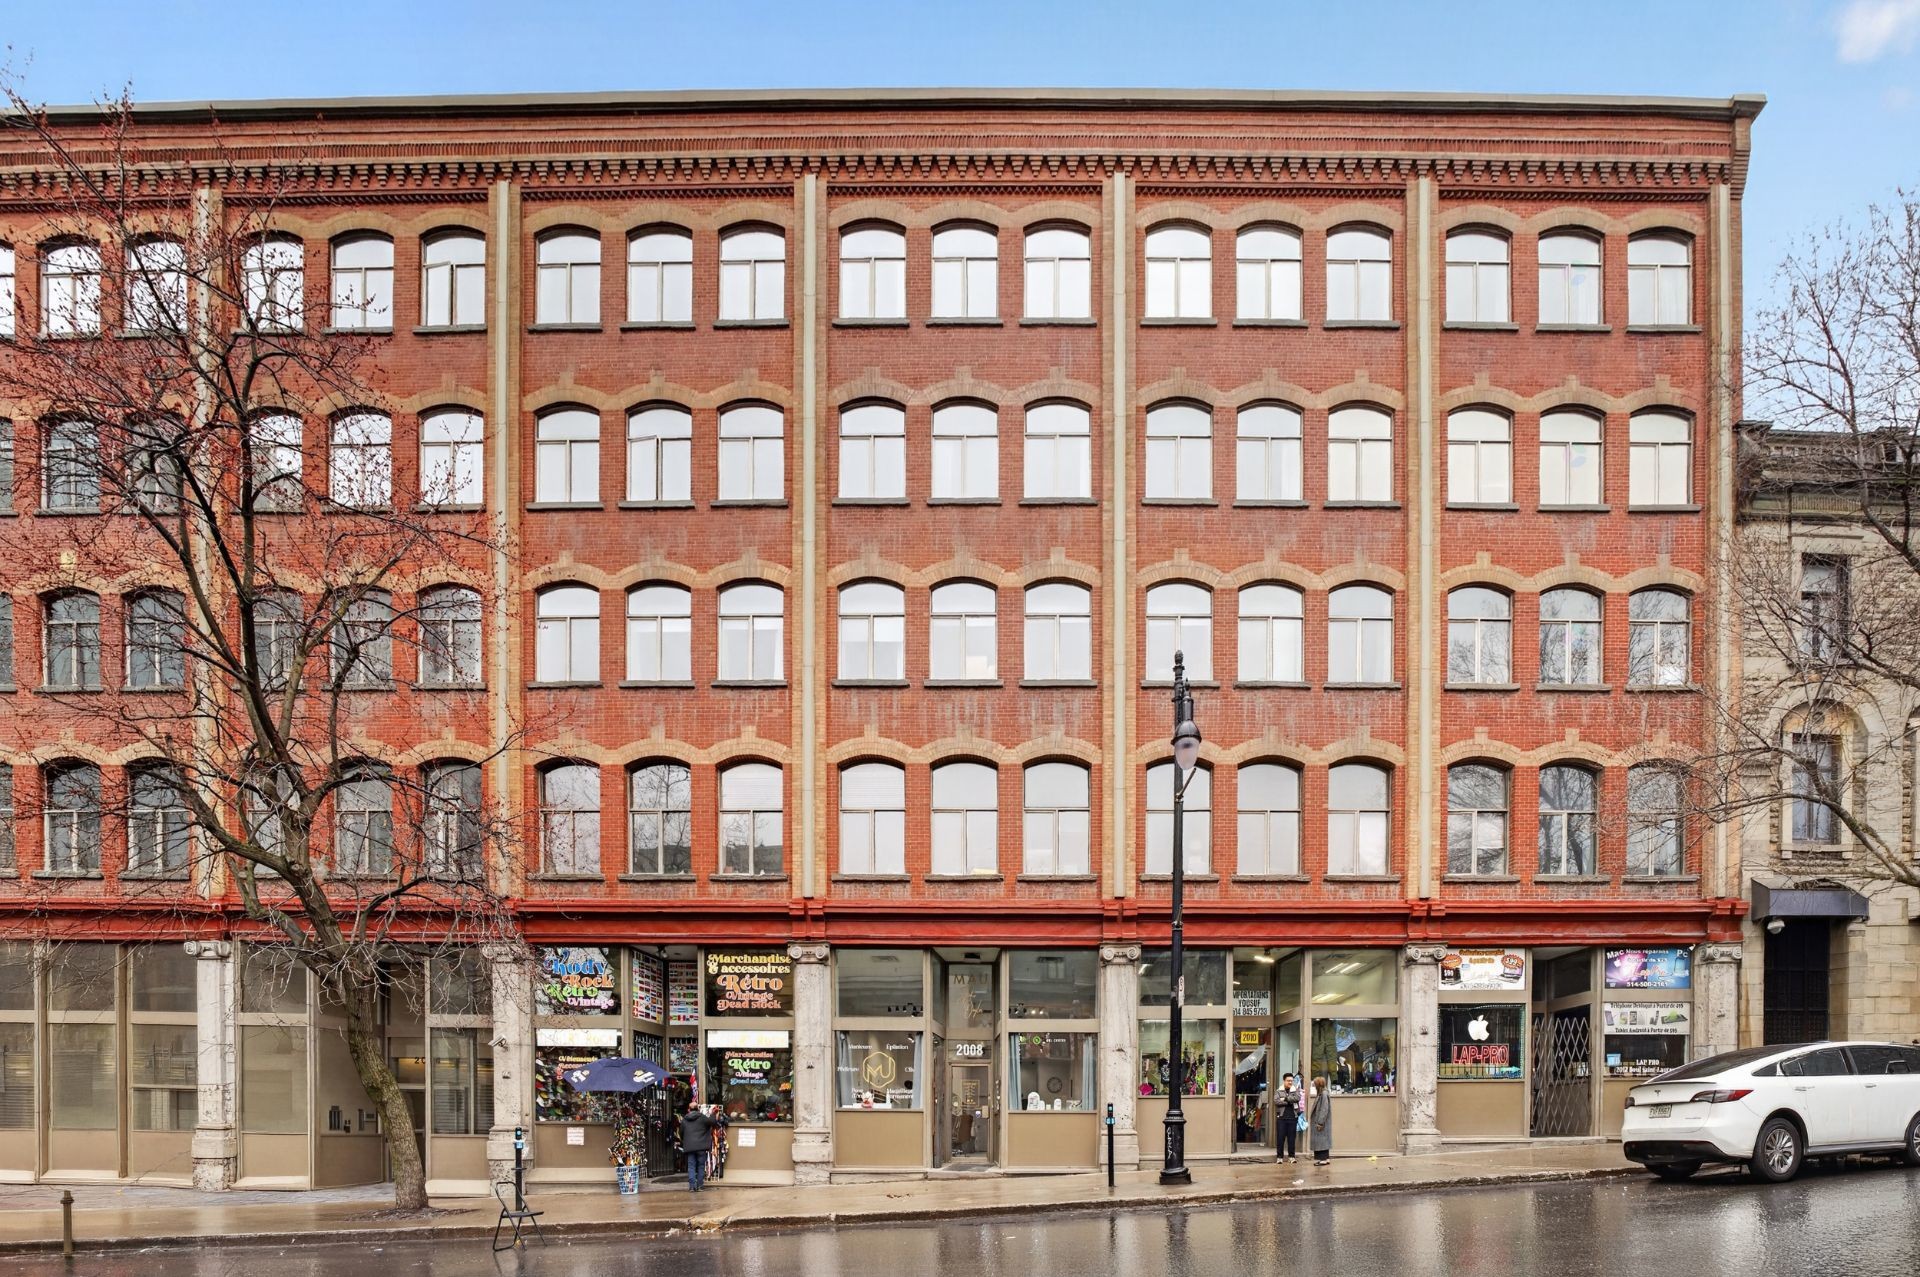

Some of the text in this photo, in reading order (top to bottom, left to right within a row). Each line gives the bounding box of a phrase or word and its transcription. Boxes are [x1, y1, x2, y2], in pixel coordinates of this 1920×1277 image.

[708, 953, 791, 964] Marchandise
[1606, 949, 1625, 959] Mac
[721, 963, 791, 974] accessoires
[562, 973, 614, 988] Rock
[717, 974, 783, 993] Rétro
[726, 990, 774, 1003] Vintage
[1233, 990, 1269, 999] MPORTATIONS
[567, 996, 614, 1009] Vintage
[717, 999, 782, 1011] Dead stock
[1242, 1007, 1253, 1015] 845
[1242, 1033, 1257, 1041] 2010
[956, 1043, 983, 1056] 2008
[1453, 1045, 1508, 1065] LAP-PRO
[728, 1058, 771, 1073] Rétro
